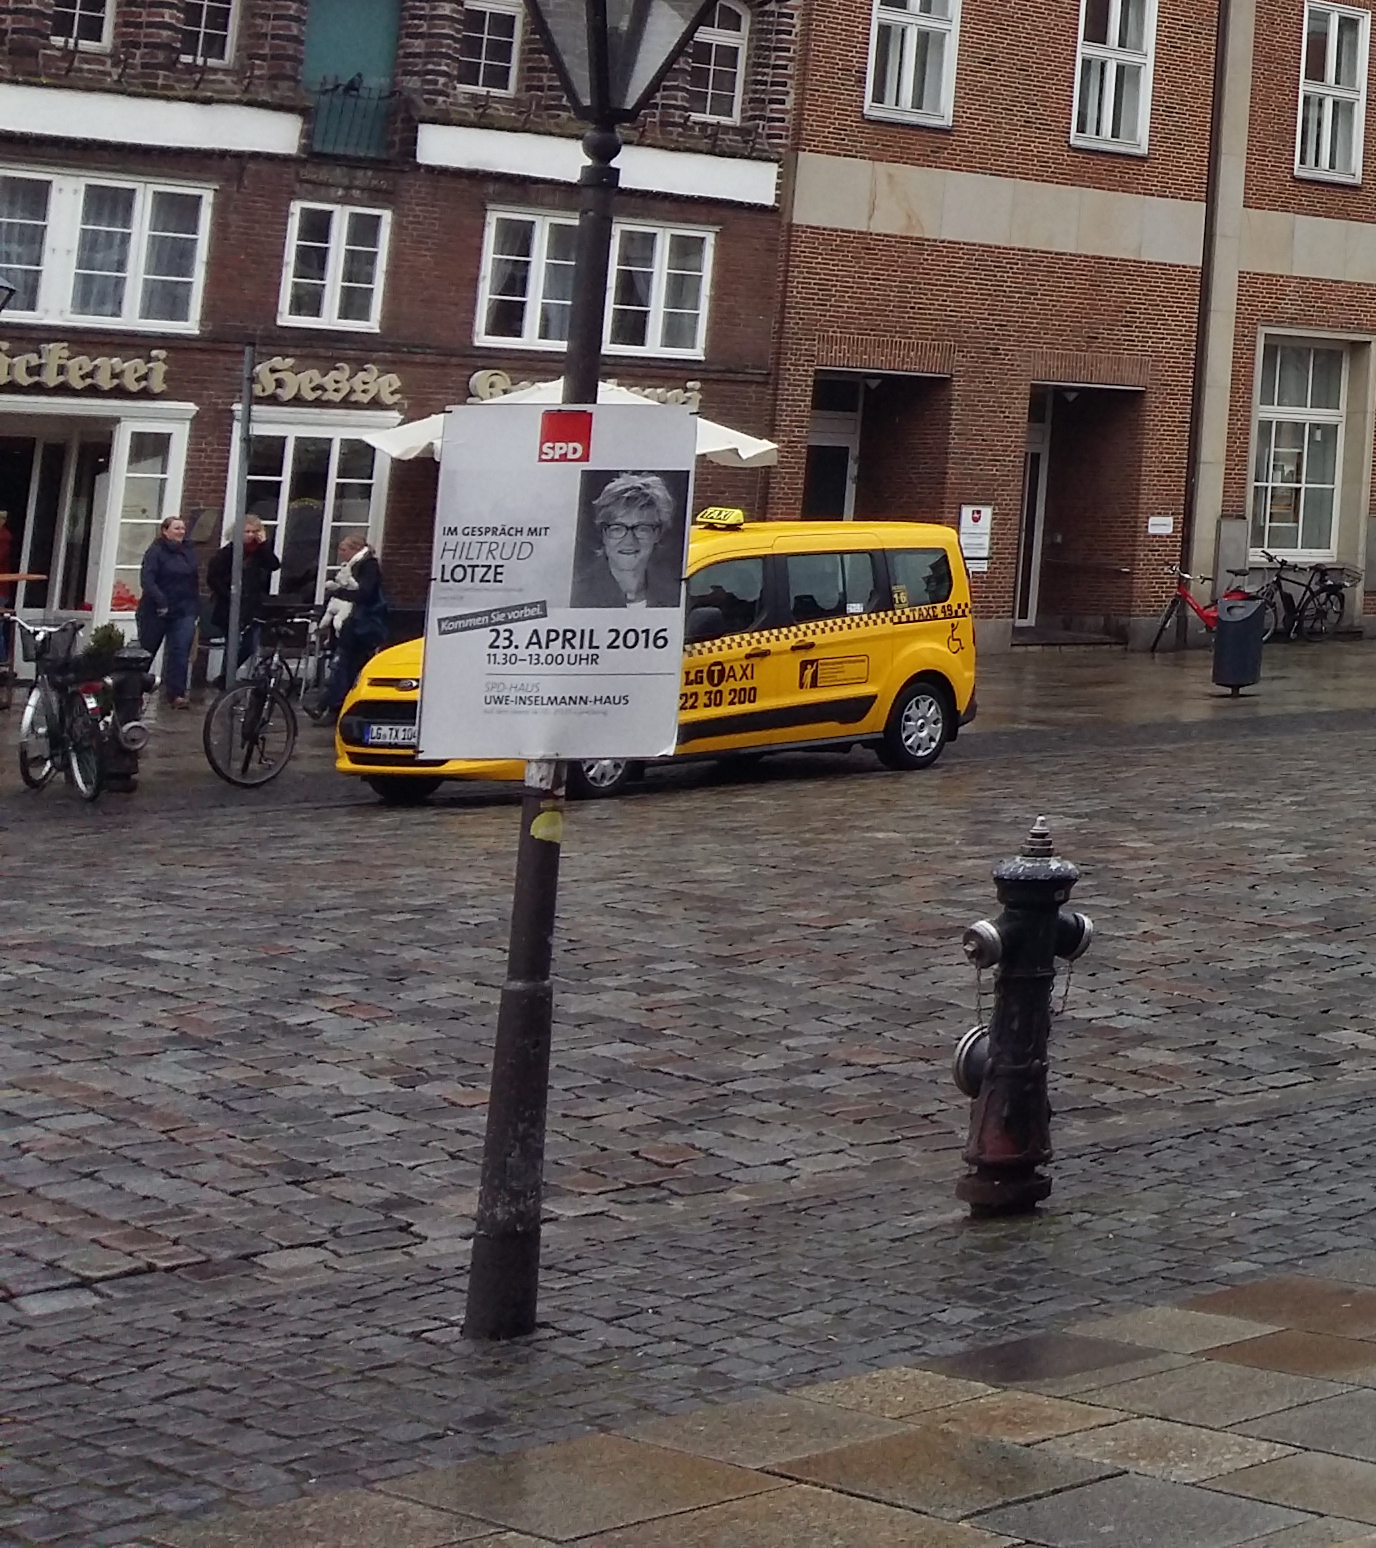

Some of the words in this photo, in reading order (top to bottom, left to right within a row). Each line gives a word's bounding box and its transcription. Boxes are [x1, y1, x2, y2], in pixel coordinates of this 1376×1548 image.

[0, 341, 168, 394] ckerei
[540, 442, 583, 460] SPD
[702, 509, 733, 520] TAXI
[442, 526, 458, 537] IM
[461, 524, 525, 537] GESPRÄCH
[527, 526, 550, 537] MIT
[440, 541, 534, 561] HILTRUD
[440, 564, 504, 583] LOTZE
[893, 592, 907, 604] 16
[440, 615, 489, 631] Kommen
[490, 611, 505, 623] Sie
[506, 604, 543, 619] vorbei.
[910, 606, 938, 620] TAXE
[487, 628, 519, 650] 23.
[525, 628, 600, 650] APRIL
[606, 627, 669, 650] 2016
[566, 653, 600, 666] UHR
[484, 694, 629, 706] UWE-INSELMANN-HAUS
[680, 691, 698, 710] 22
[703, 689, 723, 708] 30
[728, 687, 757, 706] 200
